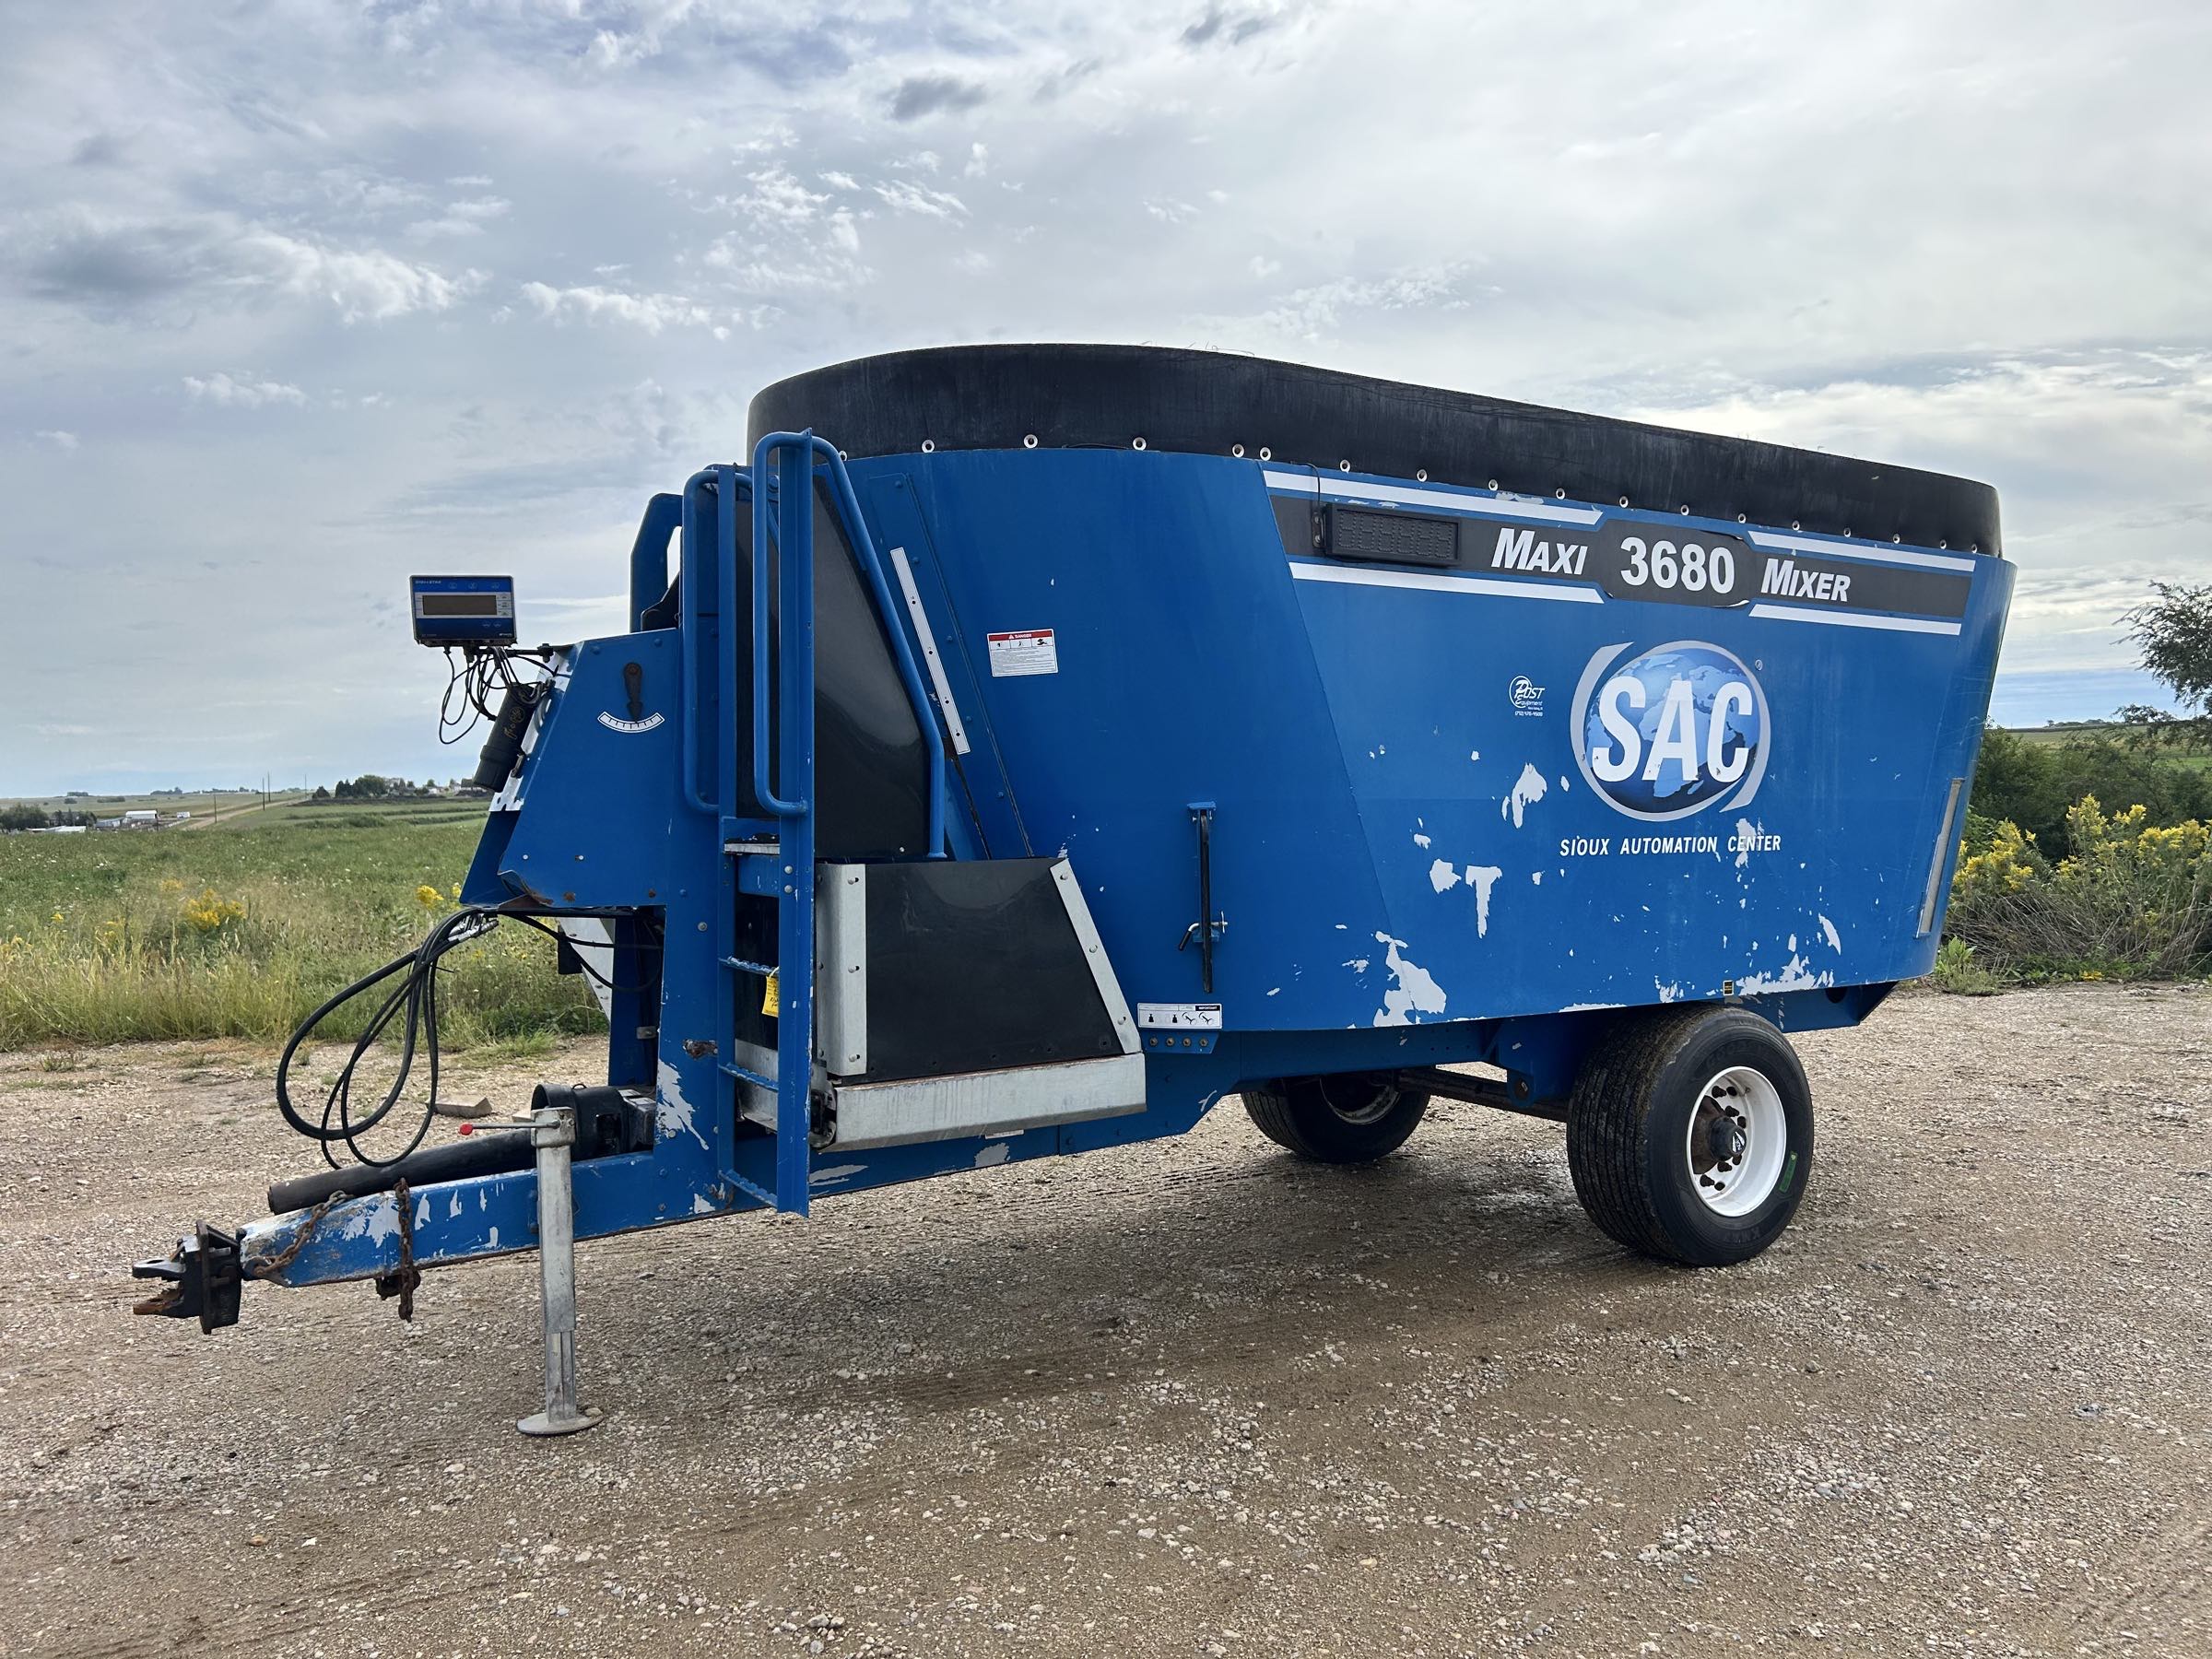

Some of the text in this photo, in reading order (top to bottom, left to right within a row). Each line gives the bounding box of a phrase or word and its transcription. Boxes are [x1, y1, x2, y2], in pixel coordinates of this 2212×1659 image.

[1619, 536, 1735, 594] 3680
[1592, 676, 1753, 782] SAC
[1559, 835, 1782, 856] SIOUX AUTOMATION CENTER
